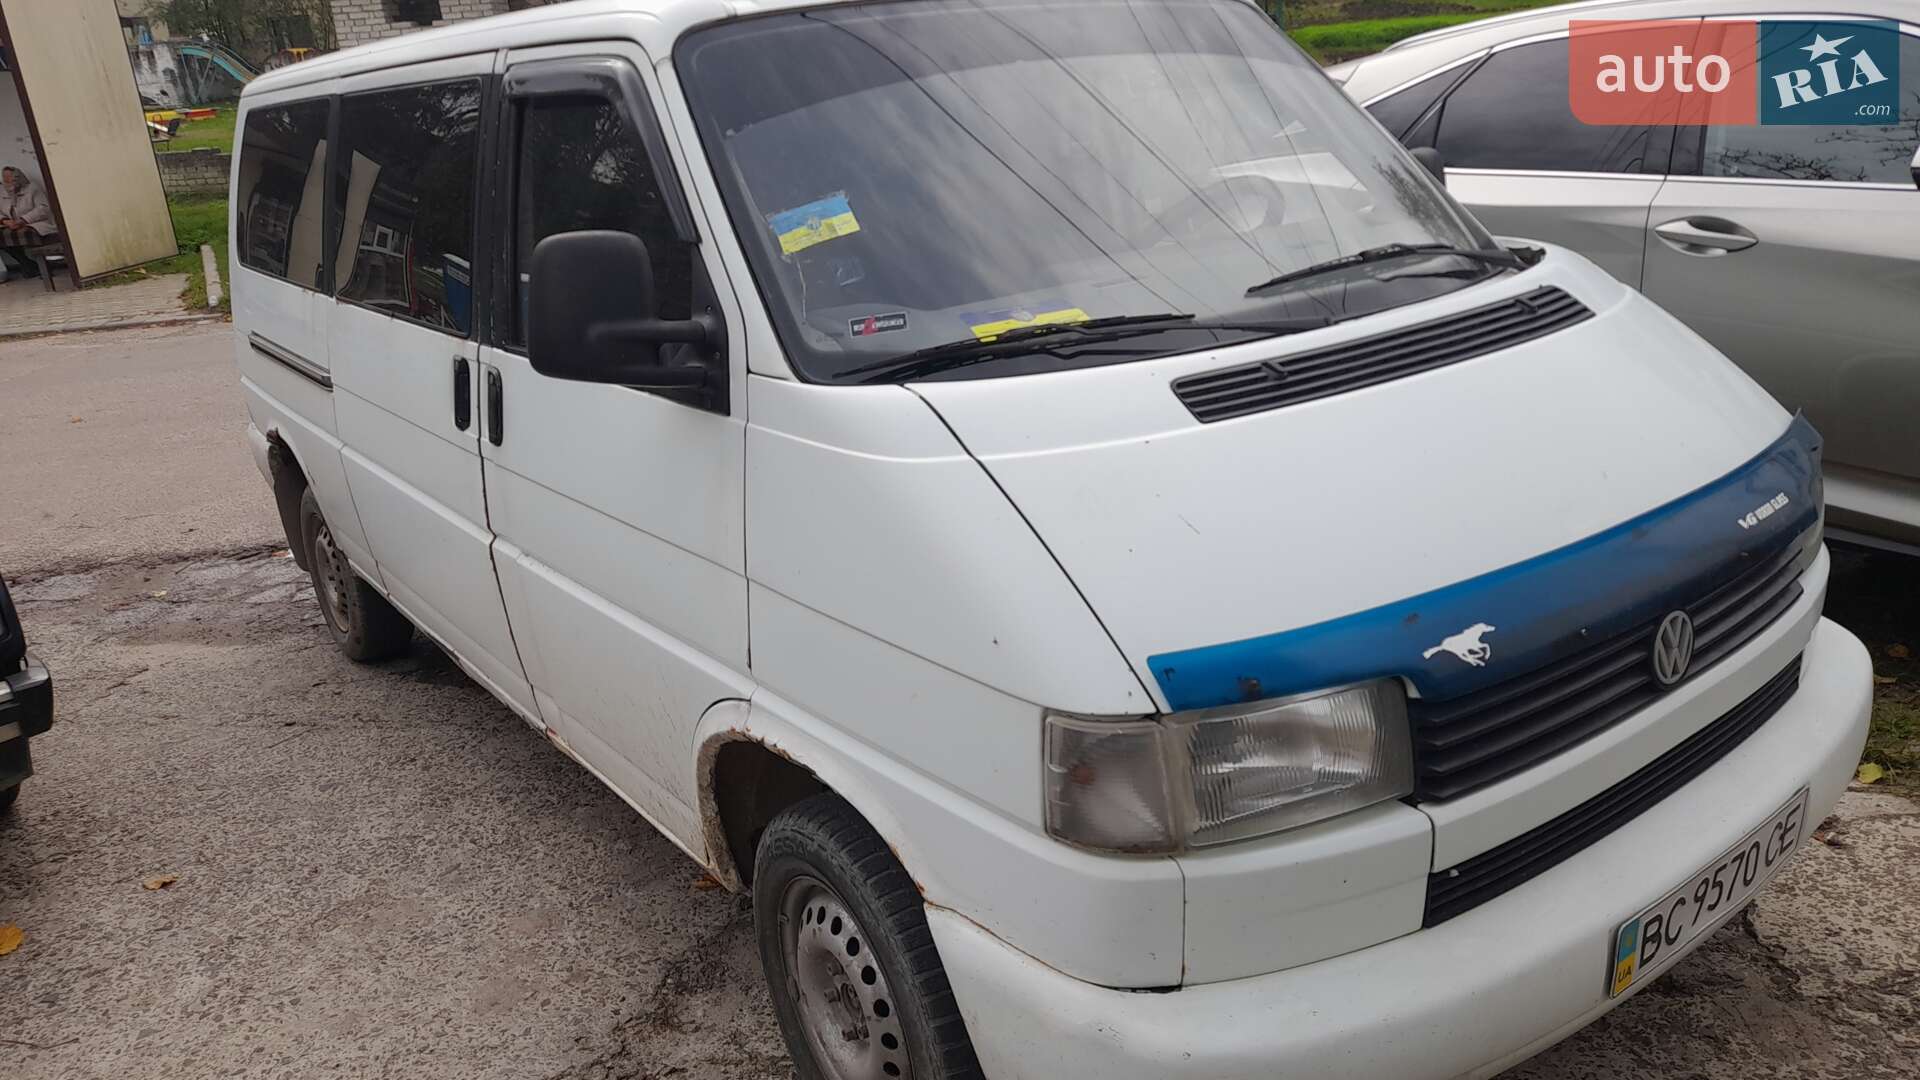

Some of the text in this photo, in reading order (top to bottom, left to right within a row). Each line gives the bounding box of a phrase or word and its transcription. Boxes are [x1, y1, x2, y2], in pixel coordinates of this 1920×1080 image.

[1639, 803, 1802, 969] BC 9570 CE
[1617, 965, 1632, 982] UA
